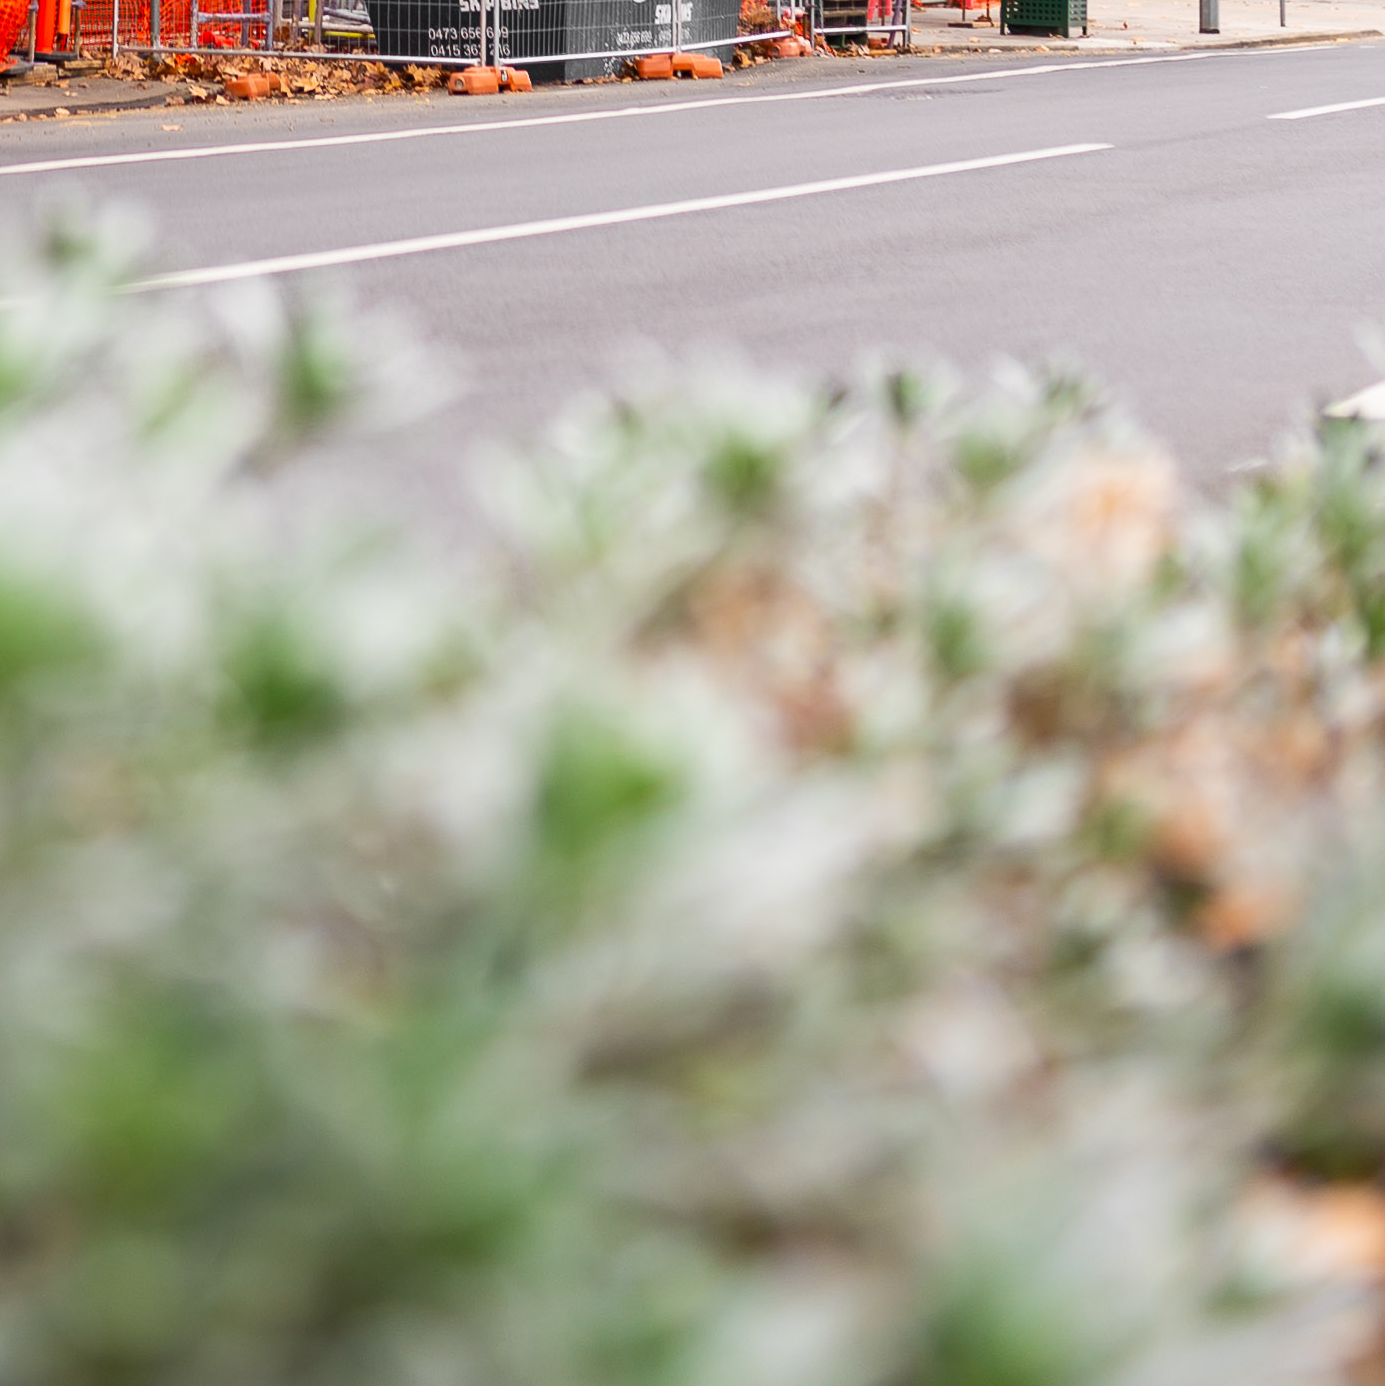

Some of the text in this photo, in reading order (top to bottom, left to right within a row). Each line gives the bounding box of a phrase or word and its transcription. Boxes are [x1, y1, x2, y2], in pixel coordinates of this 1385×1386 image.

[428, 27, 457, 41] 0473
[430, 44, 461, 58] 0415
[463, 43, 482, 57] 36
